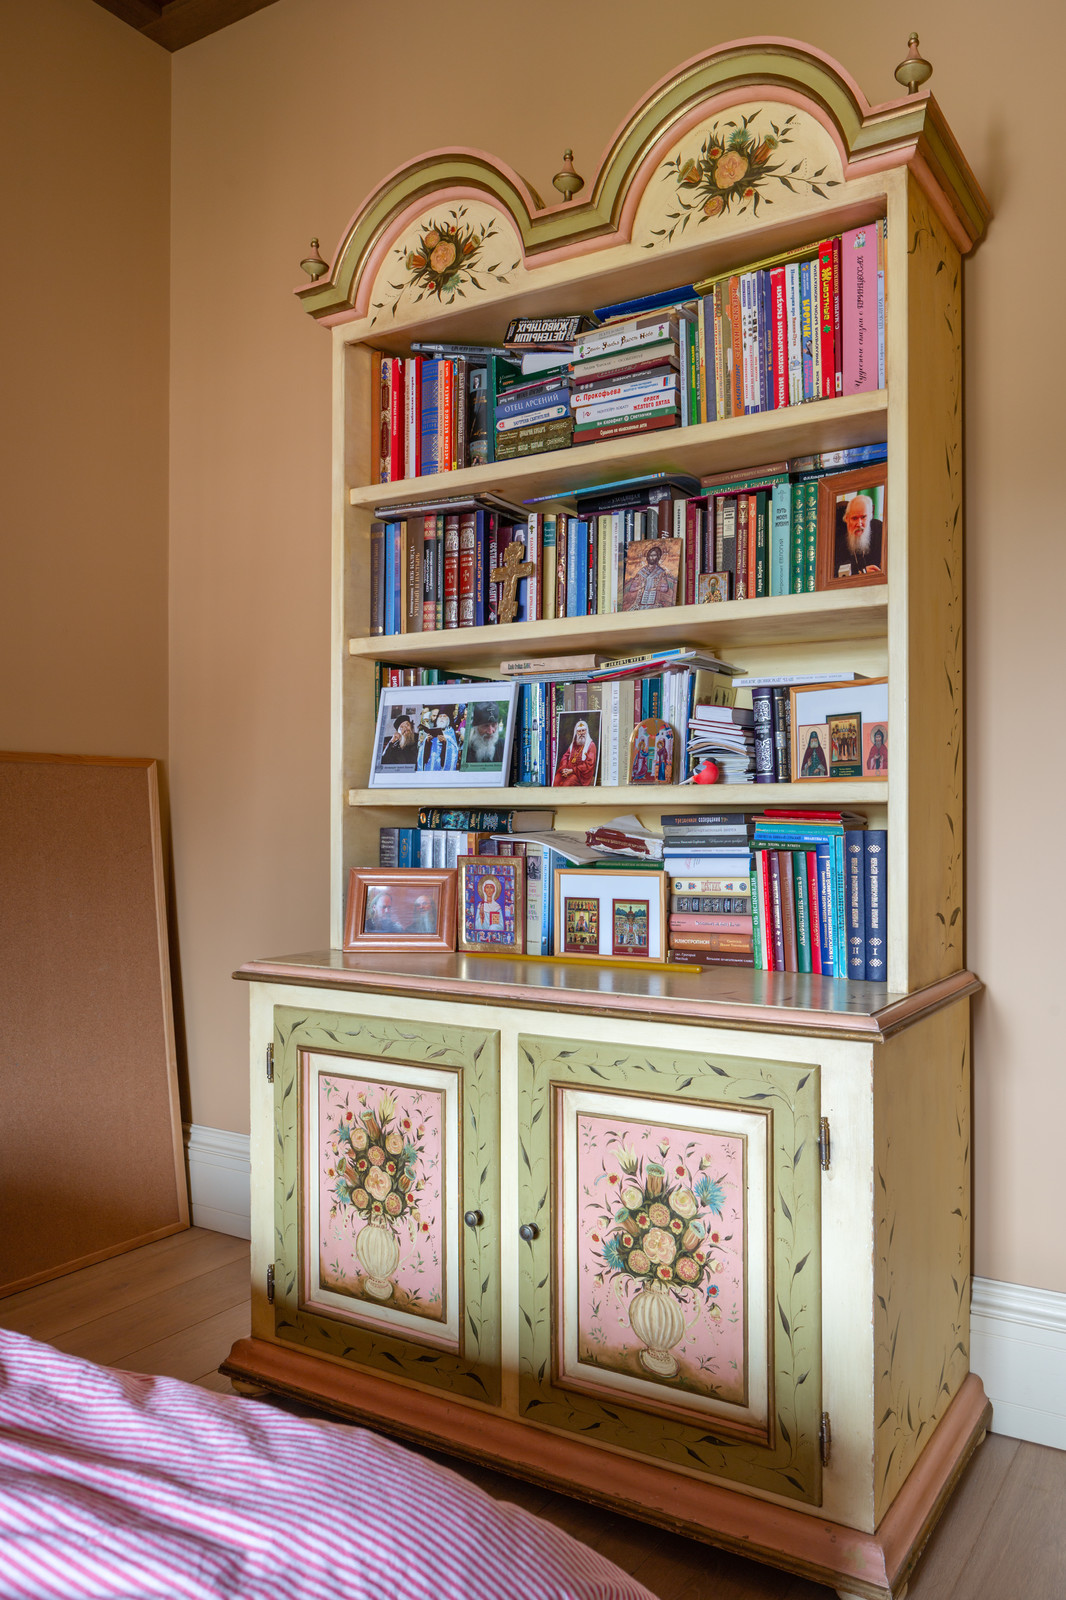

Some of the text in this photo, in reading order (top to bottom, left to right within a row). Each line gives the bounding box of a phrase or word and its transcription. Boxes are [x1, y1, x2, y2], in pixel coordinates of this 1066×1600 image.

[822, 266, 832, 321] Животные
[516, 321, 570, 333] ЖИВОТНЫХ
[802, 298, 811, 338] КРОТИК
[513, 331, 567, 343] ДЕТЕНЫШИ
[504, 392, 559, 413] ОТЕЦ АРСЕНИЙ
[583, 388, 622, 402] Прокофьева
[612, 770, 618, 781] НА
[797, 900, 806, 946] АКАФИСТНИК
[810, 900, 818, 947] АКАФИСТНИК
